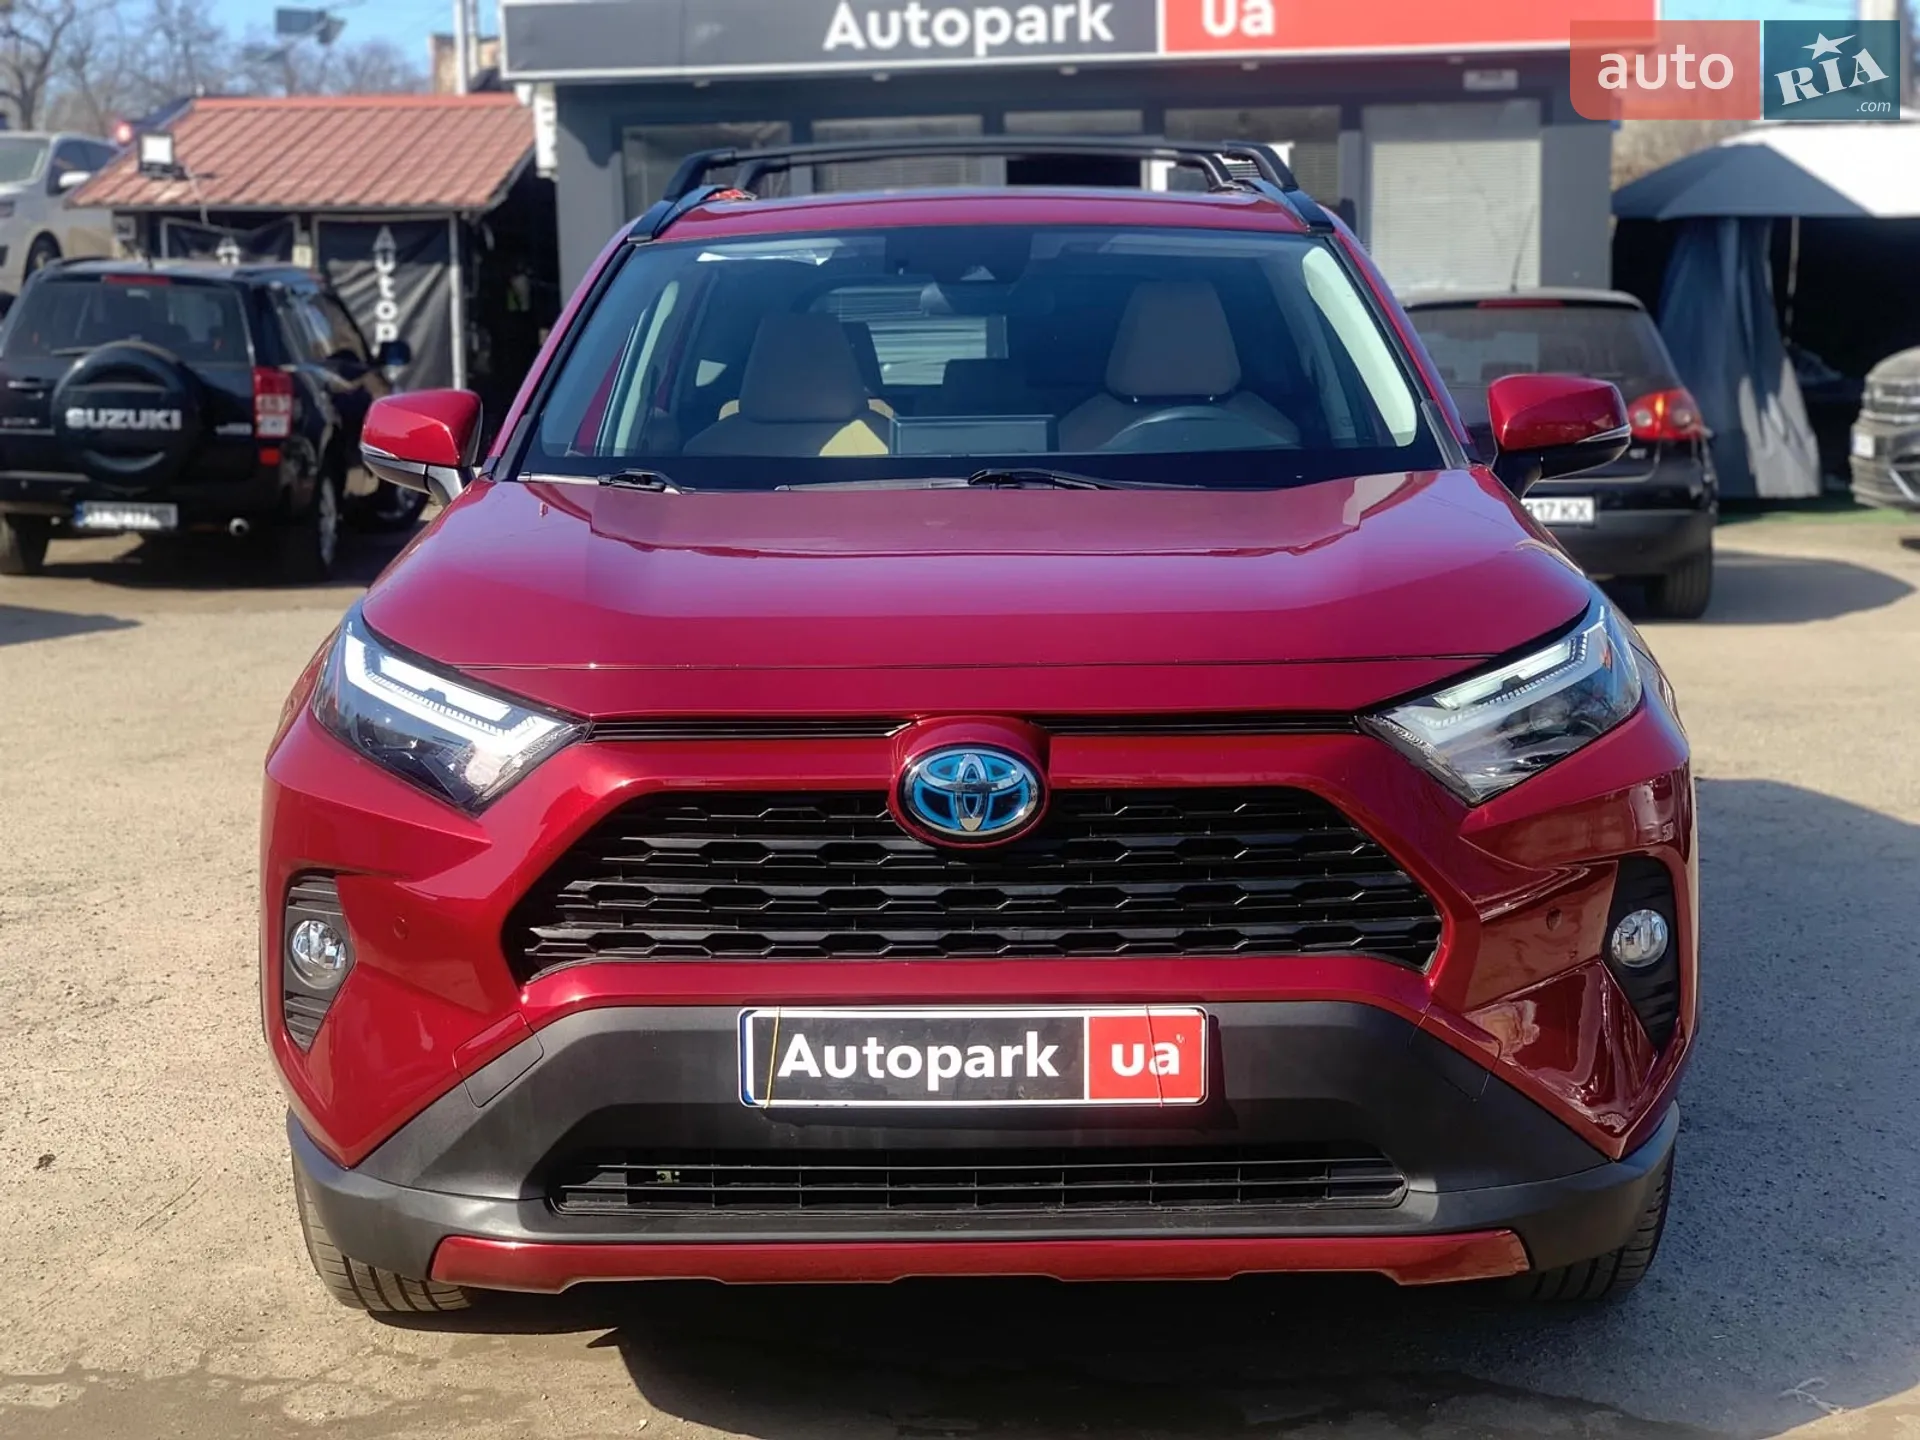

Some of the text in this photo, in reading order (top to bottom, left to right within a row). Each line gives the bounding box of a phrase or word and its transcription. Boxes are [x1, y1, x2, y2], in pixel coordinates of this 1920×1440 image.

[822, 0, 1115, 58] Autopark
[372, 224, 400, 380] Autop
[65, 407, 182, 430] SUZUKI
[777, 1031, 1180, 1091] Autopark ua
